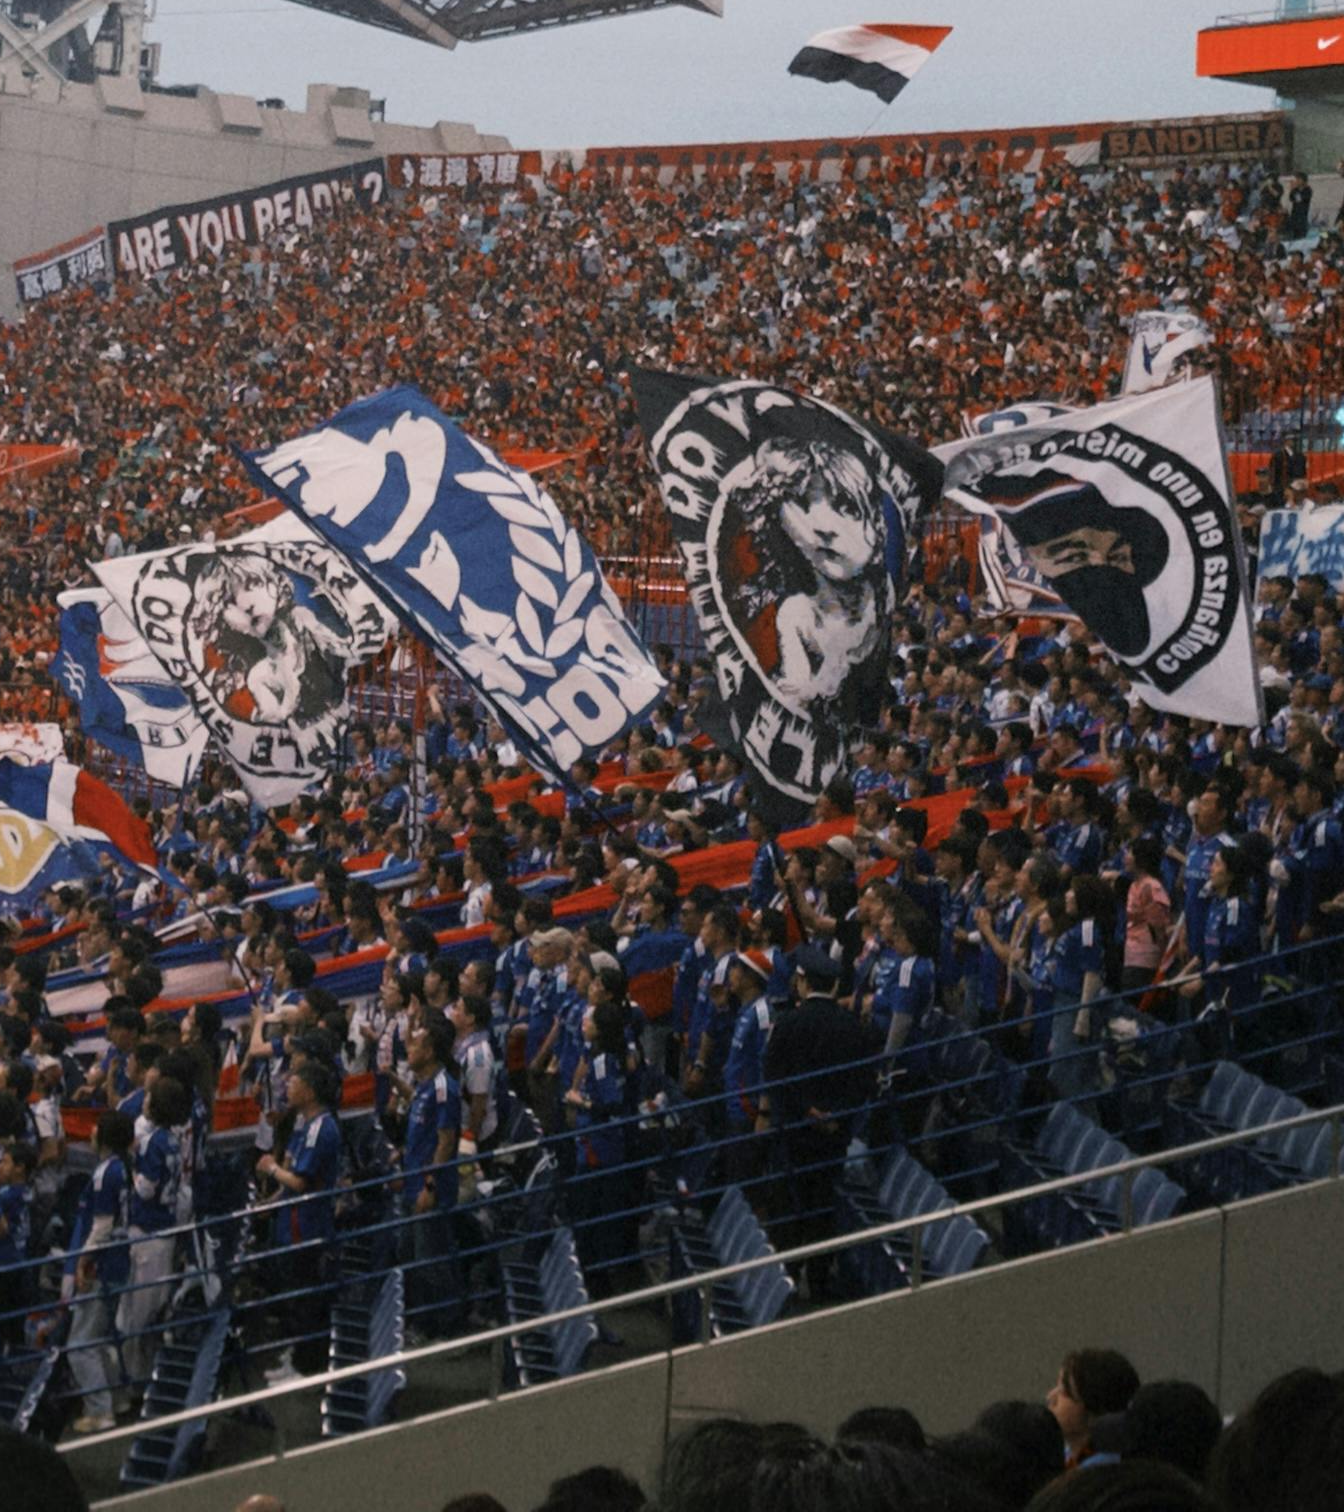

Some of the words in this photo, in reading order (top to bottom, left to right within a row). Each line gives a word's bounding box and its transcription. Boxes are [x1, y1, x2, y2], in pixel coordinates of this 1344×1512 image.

[1108, 122, 1285, 158] BANDIERA
[116, 218, 176, 275] ARE
[177, 203, 248, 262] YOU
